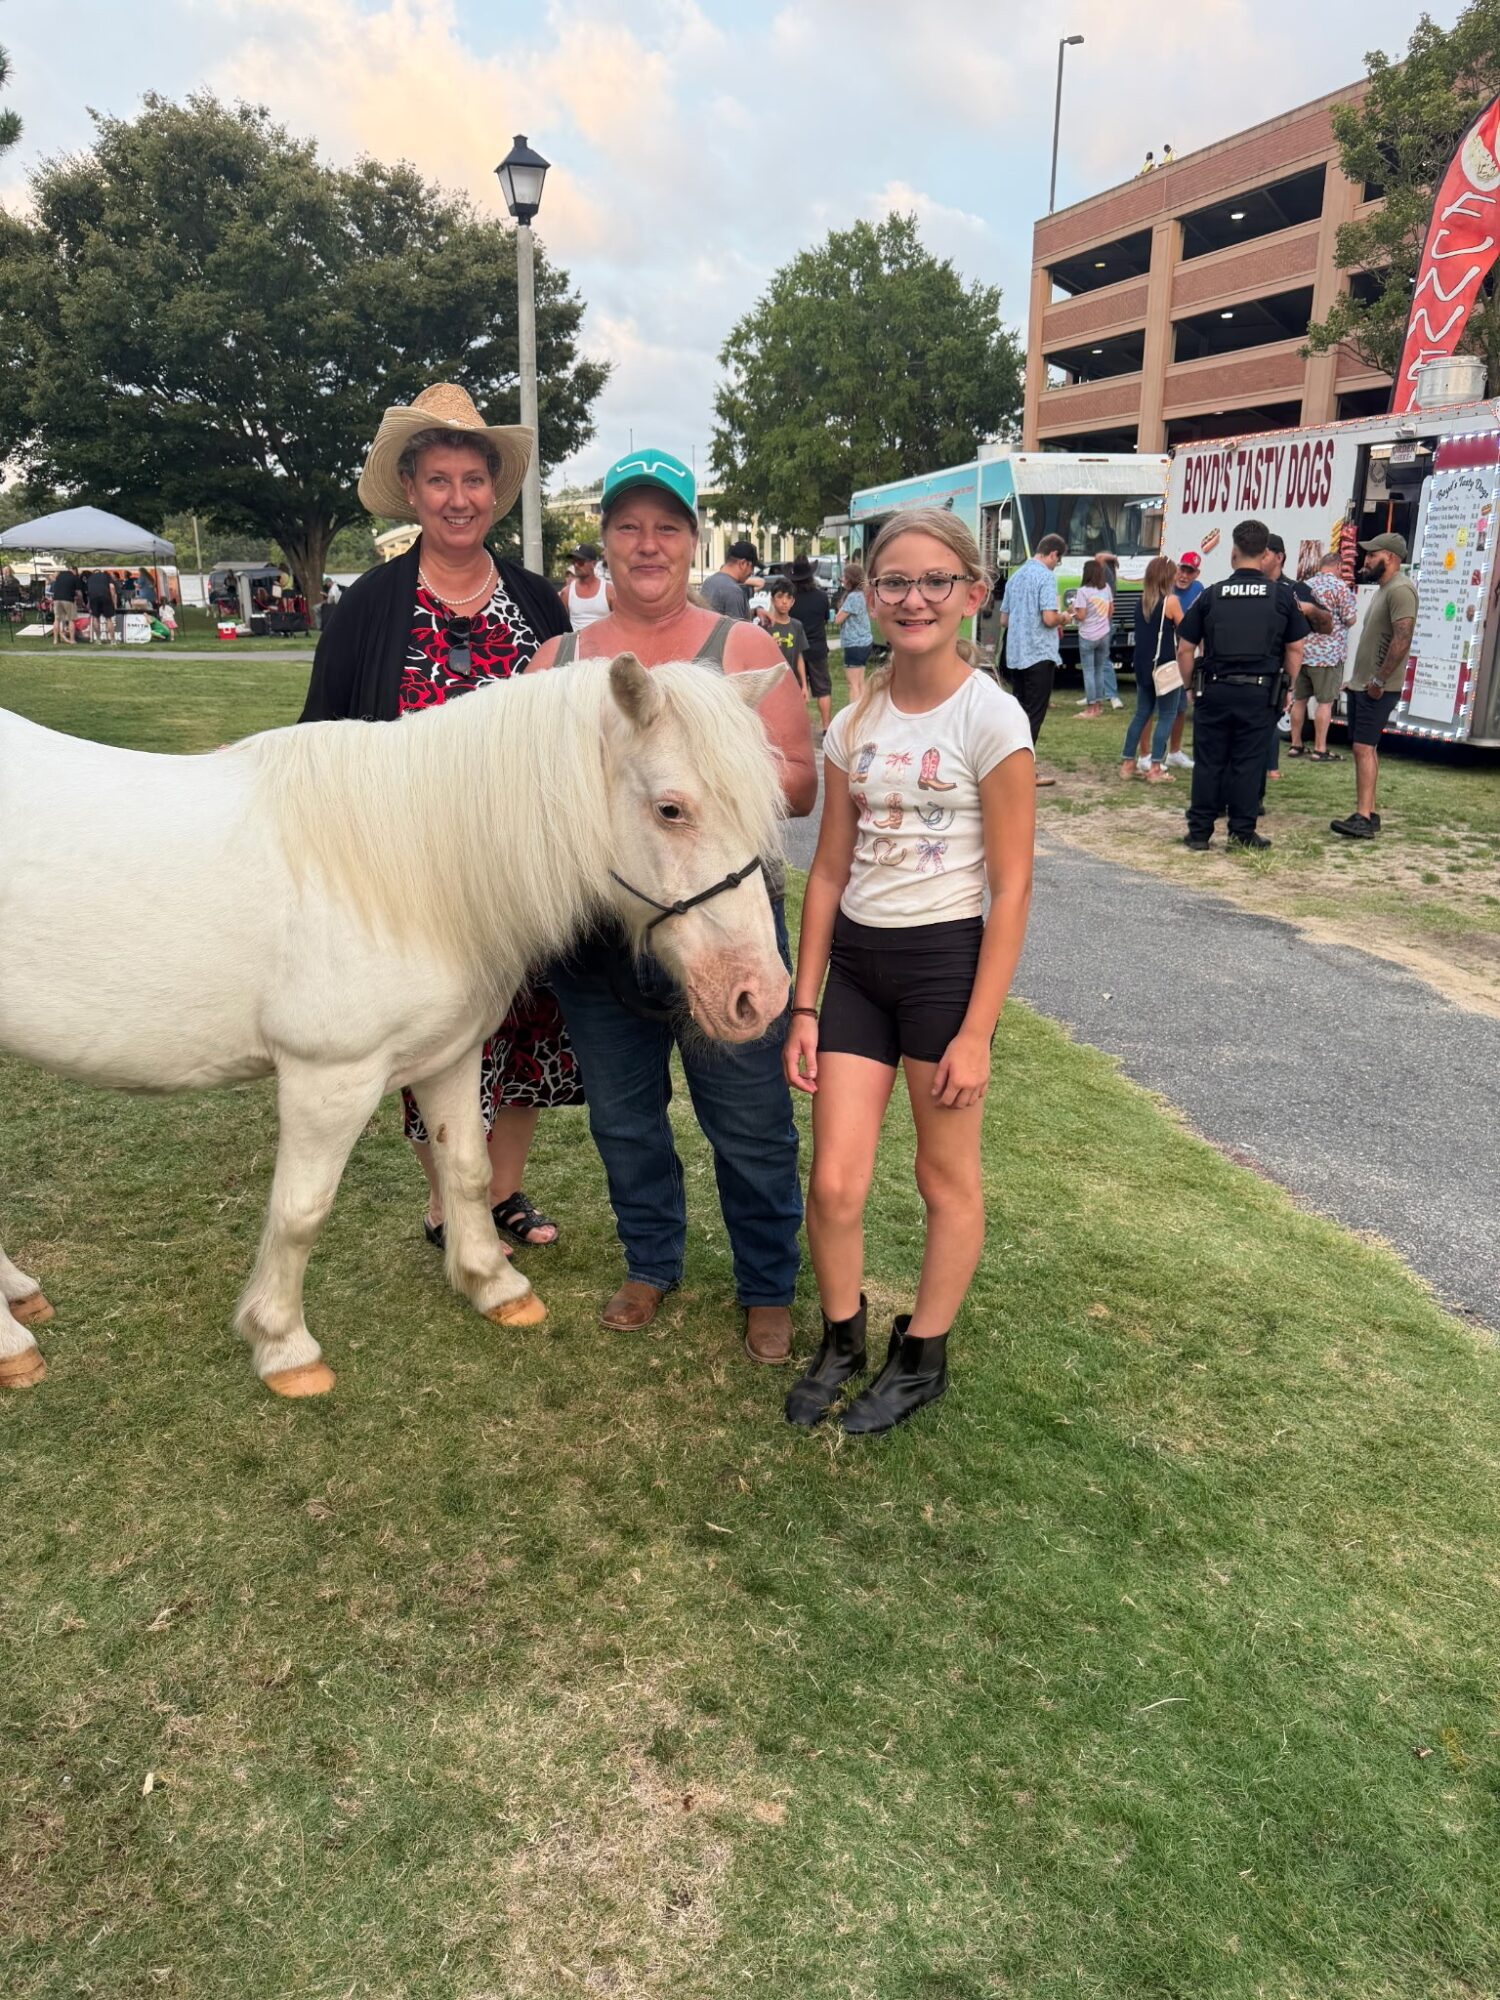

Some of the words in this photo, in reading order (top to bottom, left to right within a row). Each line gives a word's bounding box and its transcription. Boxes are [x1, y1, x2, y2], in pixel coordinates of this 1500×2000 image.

[1182, 451, 1232, 514] BOYD'S
[1235, 445, 1286, 511] TASTY
[1285, 438, 1335, 508] DOGS
[1221, 584, 1267, 596] POLICE
